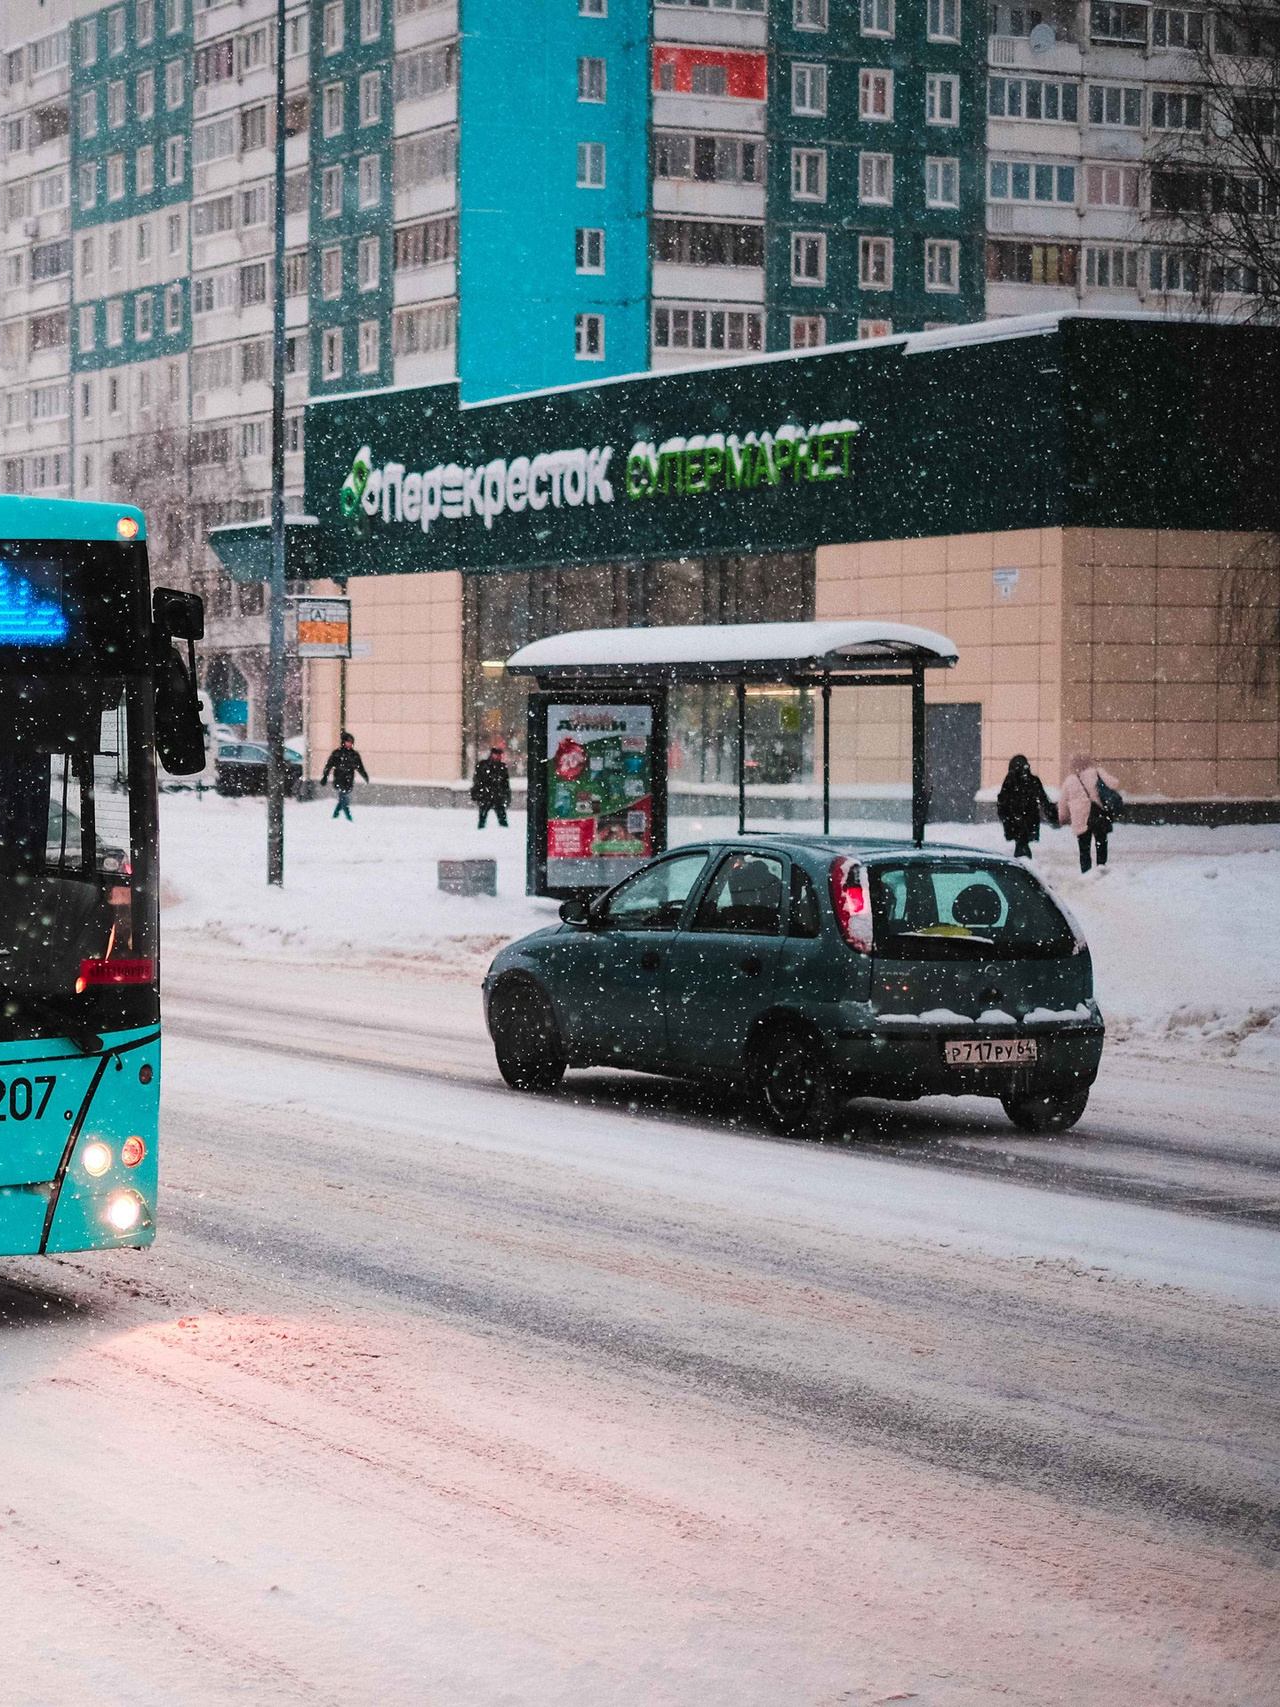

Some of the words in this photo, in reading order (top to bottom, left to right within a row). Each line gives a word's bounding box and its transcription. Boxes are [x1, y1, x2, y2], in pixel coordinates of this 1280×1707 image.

[382, 446, 614, 533] Перекресток
[626, 426, 858, 499] СУПЕРМАРКЕТ
[1017, 1041, 1032, 1055] 64
